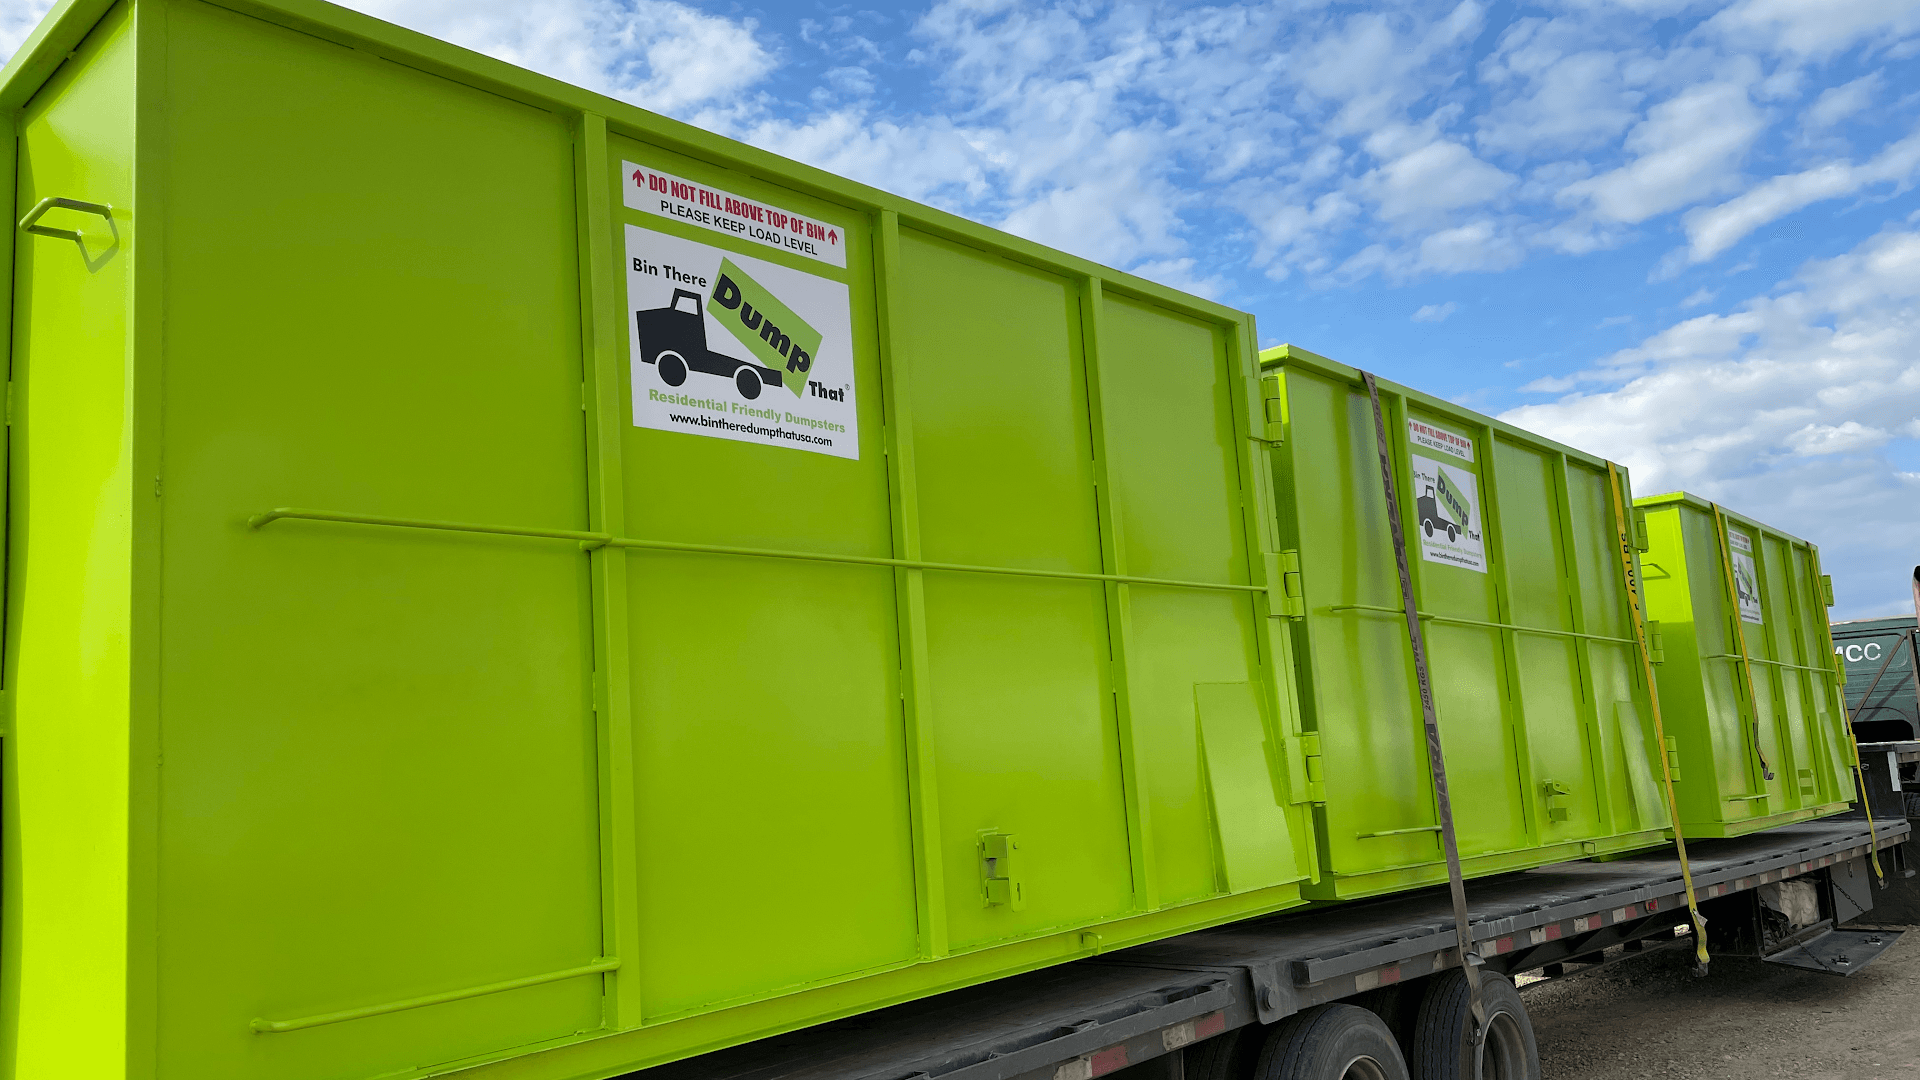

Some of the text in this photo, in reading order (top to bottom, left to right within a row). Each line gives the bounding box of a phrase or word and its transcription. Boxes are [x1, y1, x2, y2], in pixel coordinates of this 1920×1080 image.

[649, 173, 825, 241] DO NOT FILL ABOVE TOP OF BIN
[661, 200, 818, 255] PLEASE KEEP LOAD LEVEL
[633, 257, 707, 287] Bin There
[713, 273, 810, 374] Dump
[649, 389, 845, 433] Residential Friendly Dumpsters
[670, 414, 832, 447] www.bintheredumpthatusa.com
[1417, 436, 1432, 447] PLEASE
[1433, 440, 1443, 450] KEEP
[1422, 473, 1435, 483] There
[1437, 475, 1468, 526] Dump
